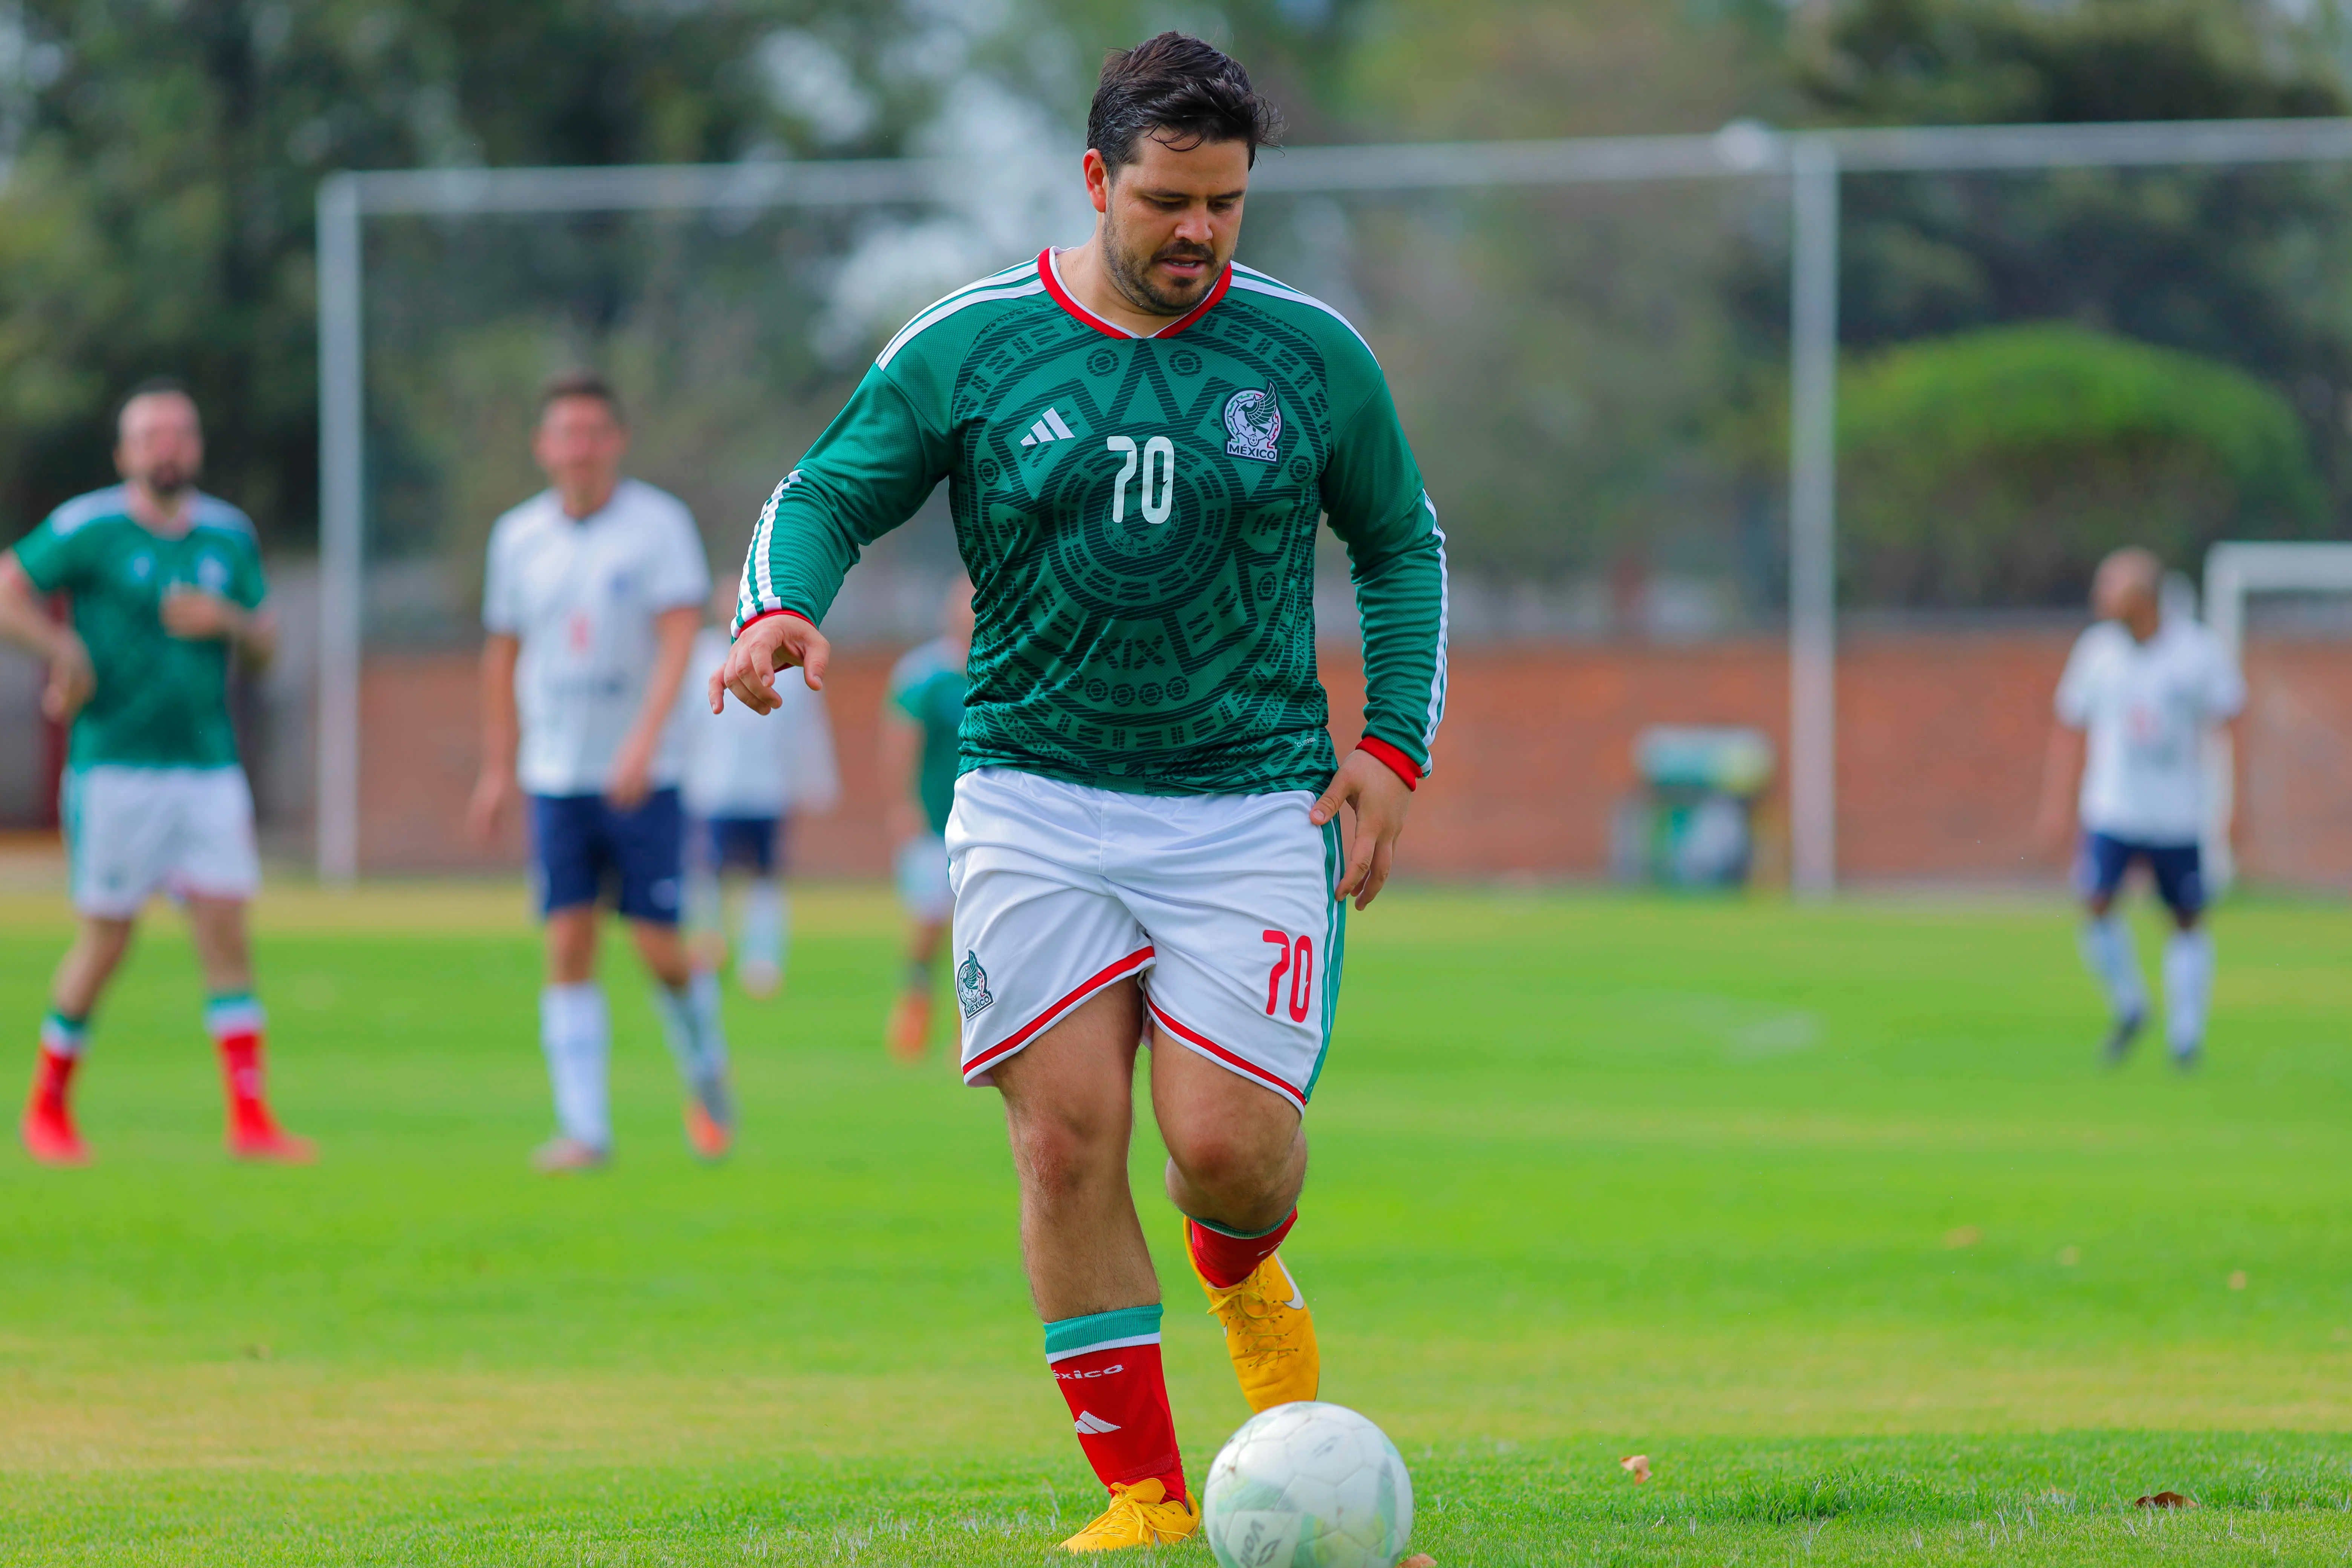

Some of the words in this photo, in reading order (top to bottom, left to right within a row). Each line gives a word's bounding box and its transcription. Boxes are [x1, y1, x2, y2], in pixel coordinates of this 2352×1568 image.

[1229, 444, 1276, 459] MÉXICO
[1107, 436, 1174, 524] 70
[1263, 930, 1312, 1023] 70
[967, 996, 990, 1015] MÉXICO
[1053, 1364, 1124, 1379] éxico
